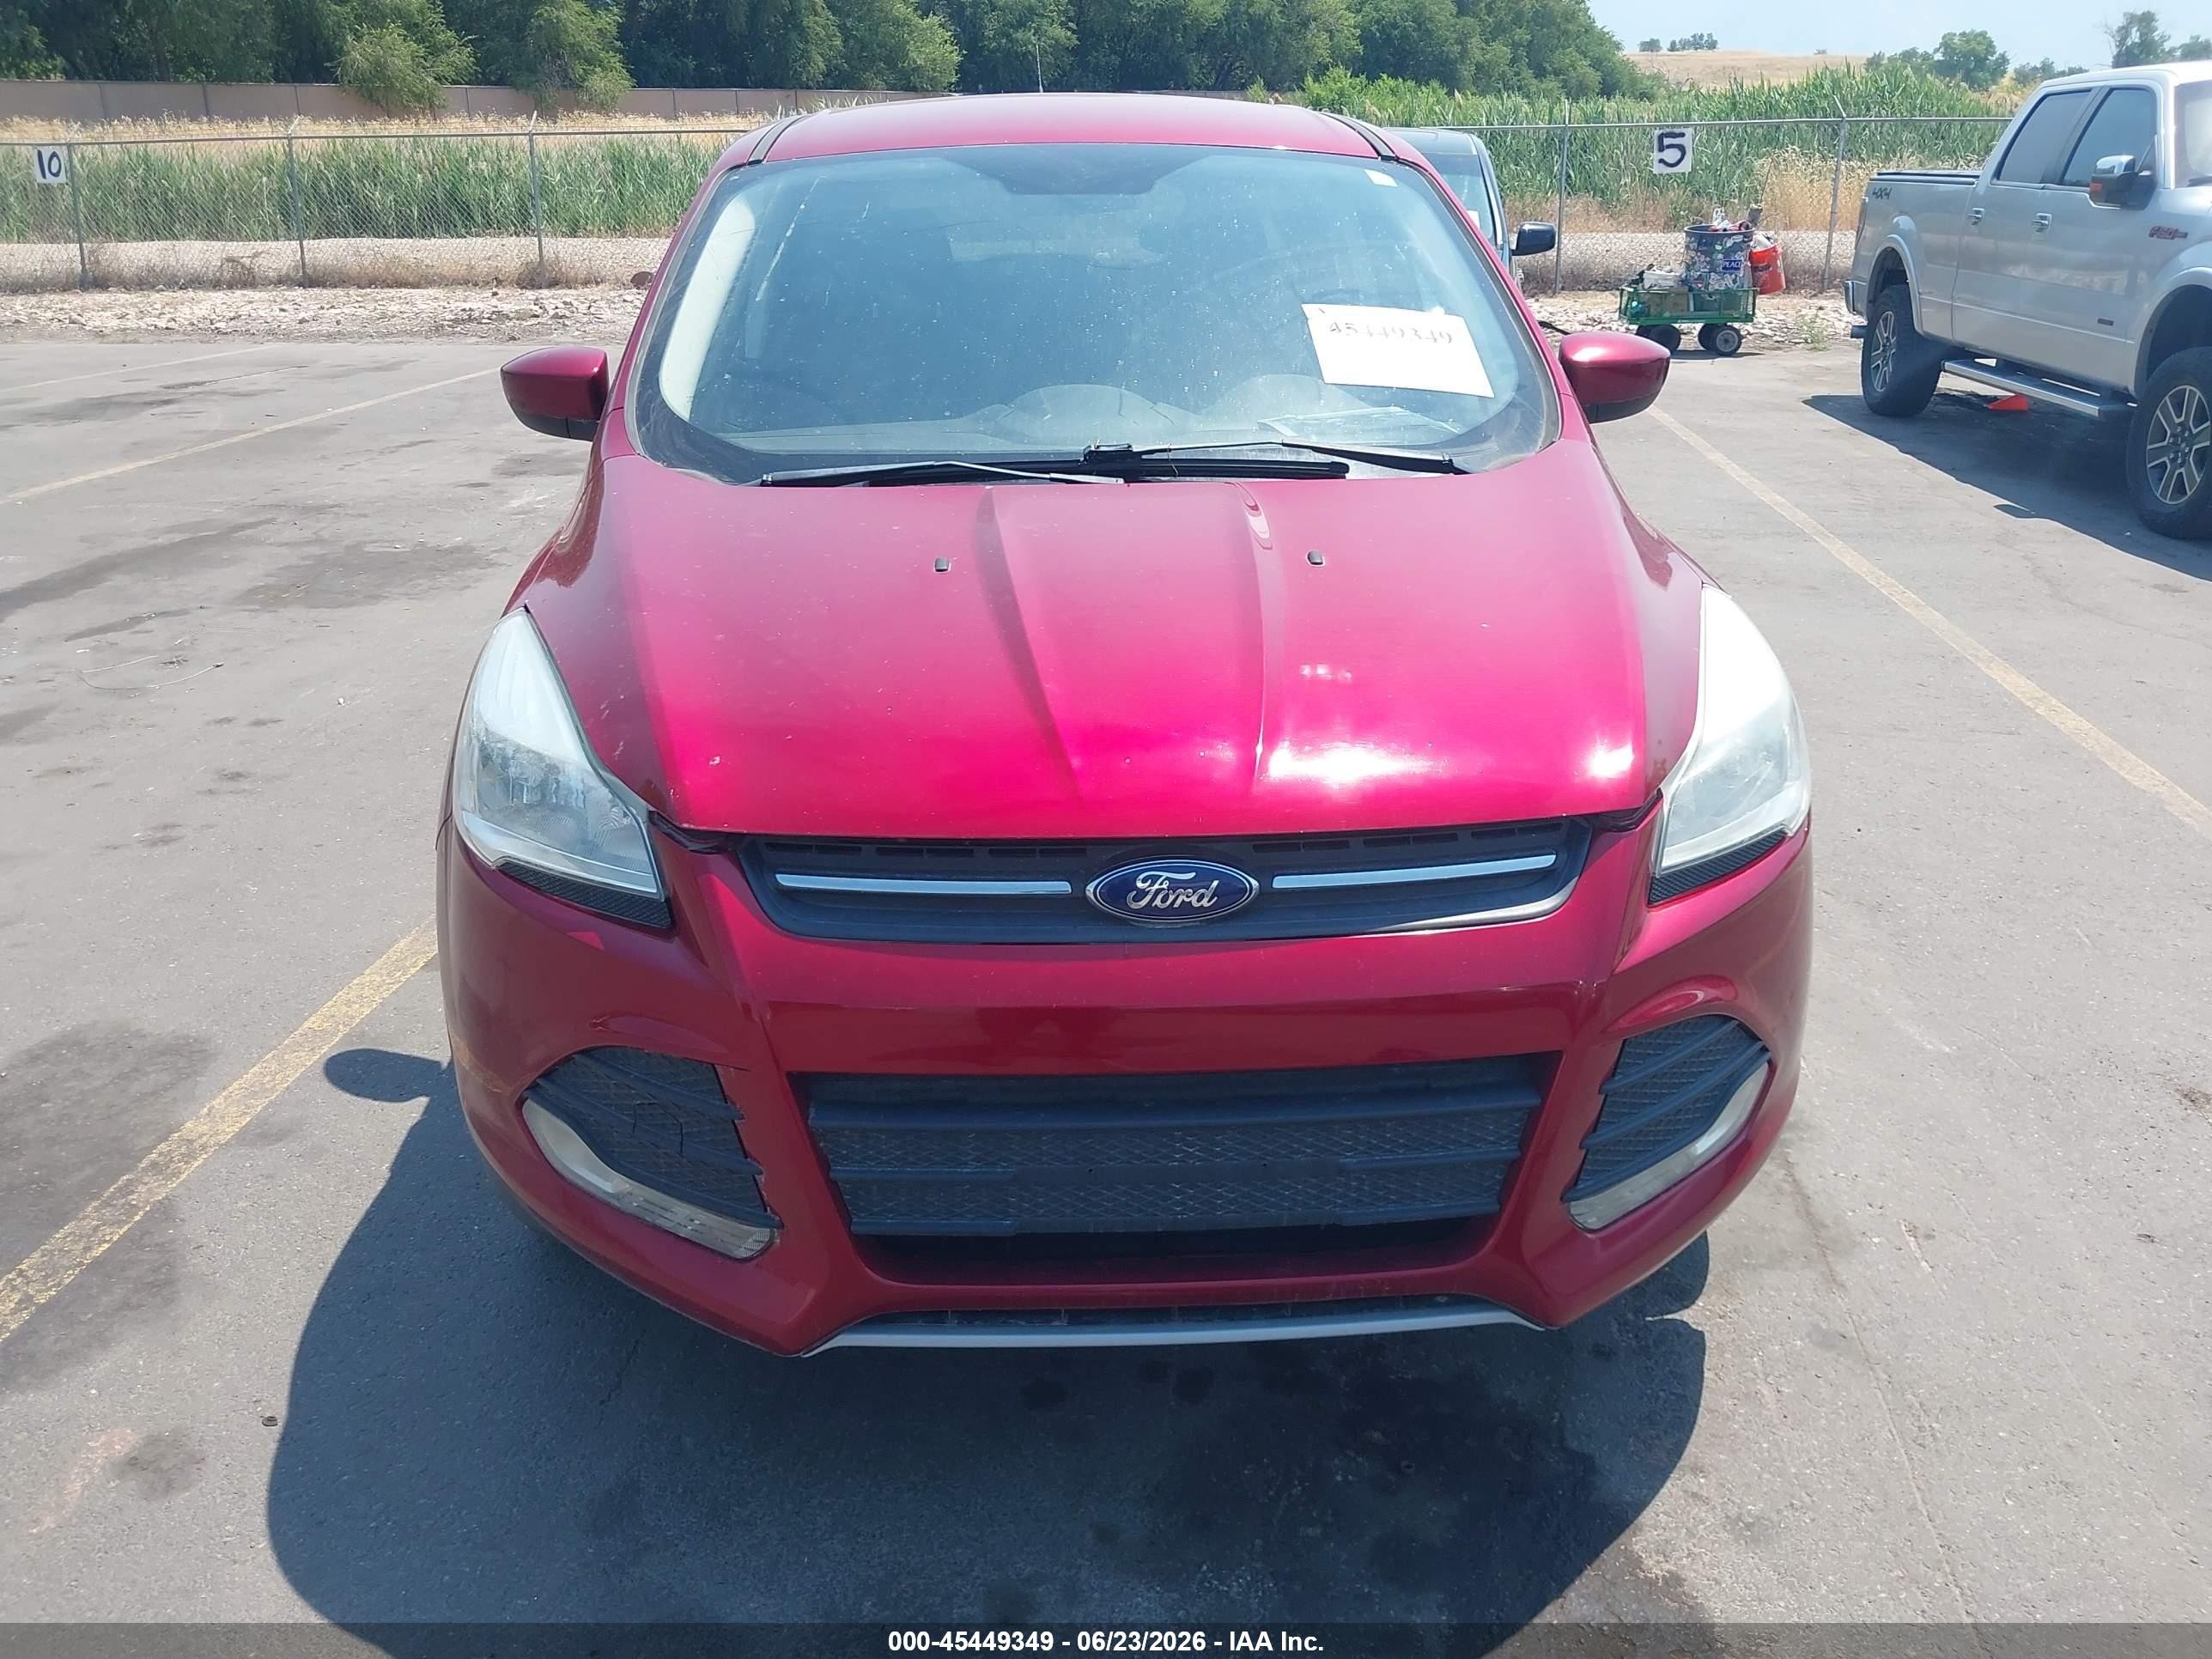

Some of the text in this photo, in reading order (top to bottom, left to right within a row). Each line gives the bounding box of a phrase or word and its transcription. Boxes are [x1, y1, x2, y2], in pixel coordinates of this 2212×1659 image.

[37, 149, 62, 179] 10
[1658, 131, 1686, 167] 5
[1126, 871, 1219, 909] Ford
